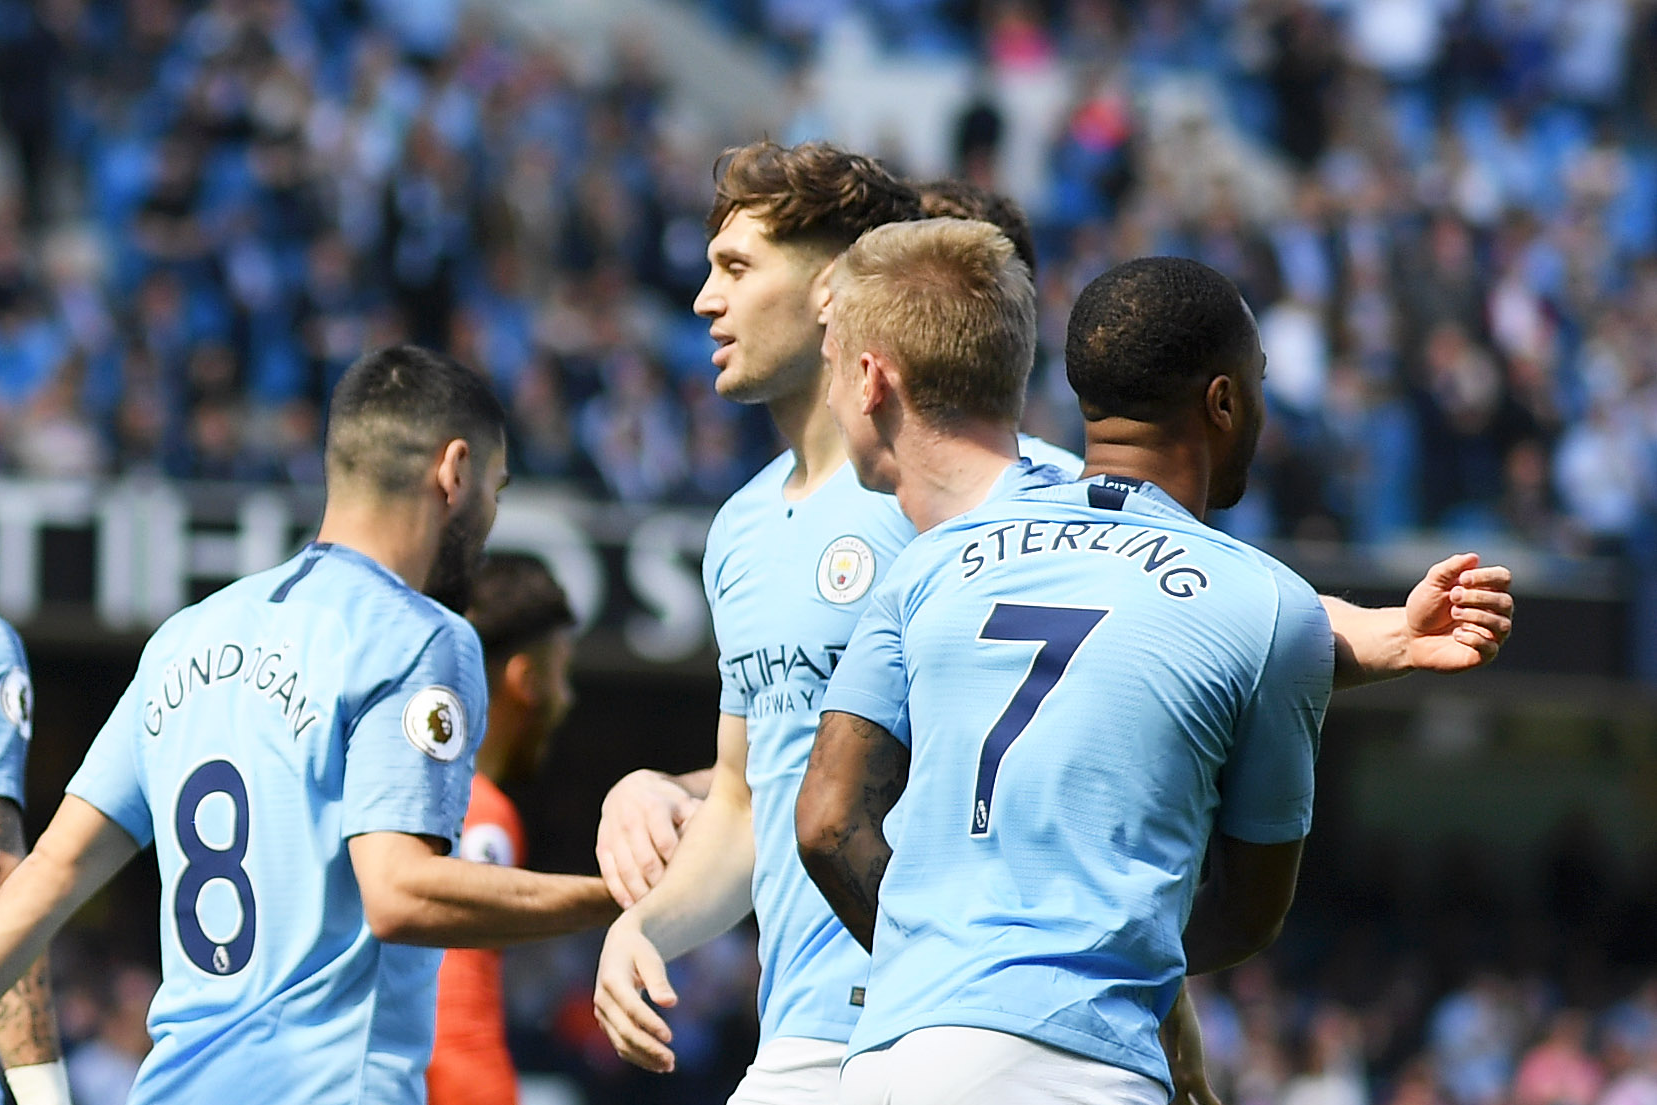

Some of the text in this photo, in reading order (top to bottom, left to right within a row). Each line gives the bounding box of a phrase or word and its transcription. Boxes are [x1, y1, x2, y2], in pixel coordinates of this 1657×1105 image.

[961, 521, 1210, 600] STERLING
[970, 602, 1111, 836] 7
[175, 759, 256, 976] 8
